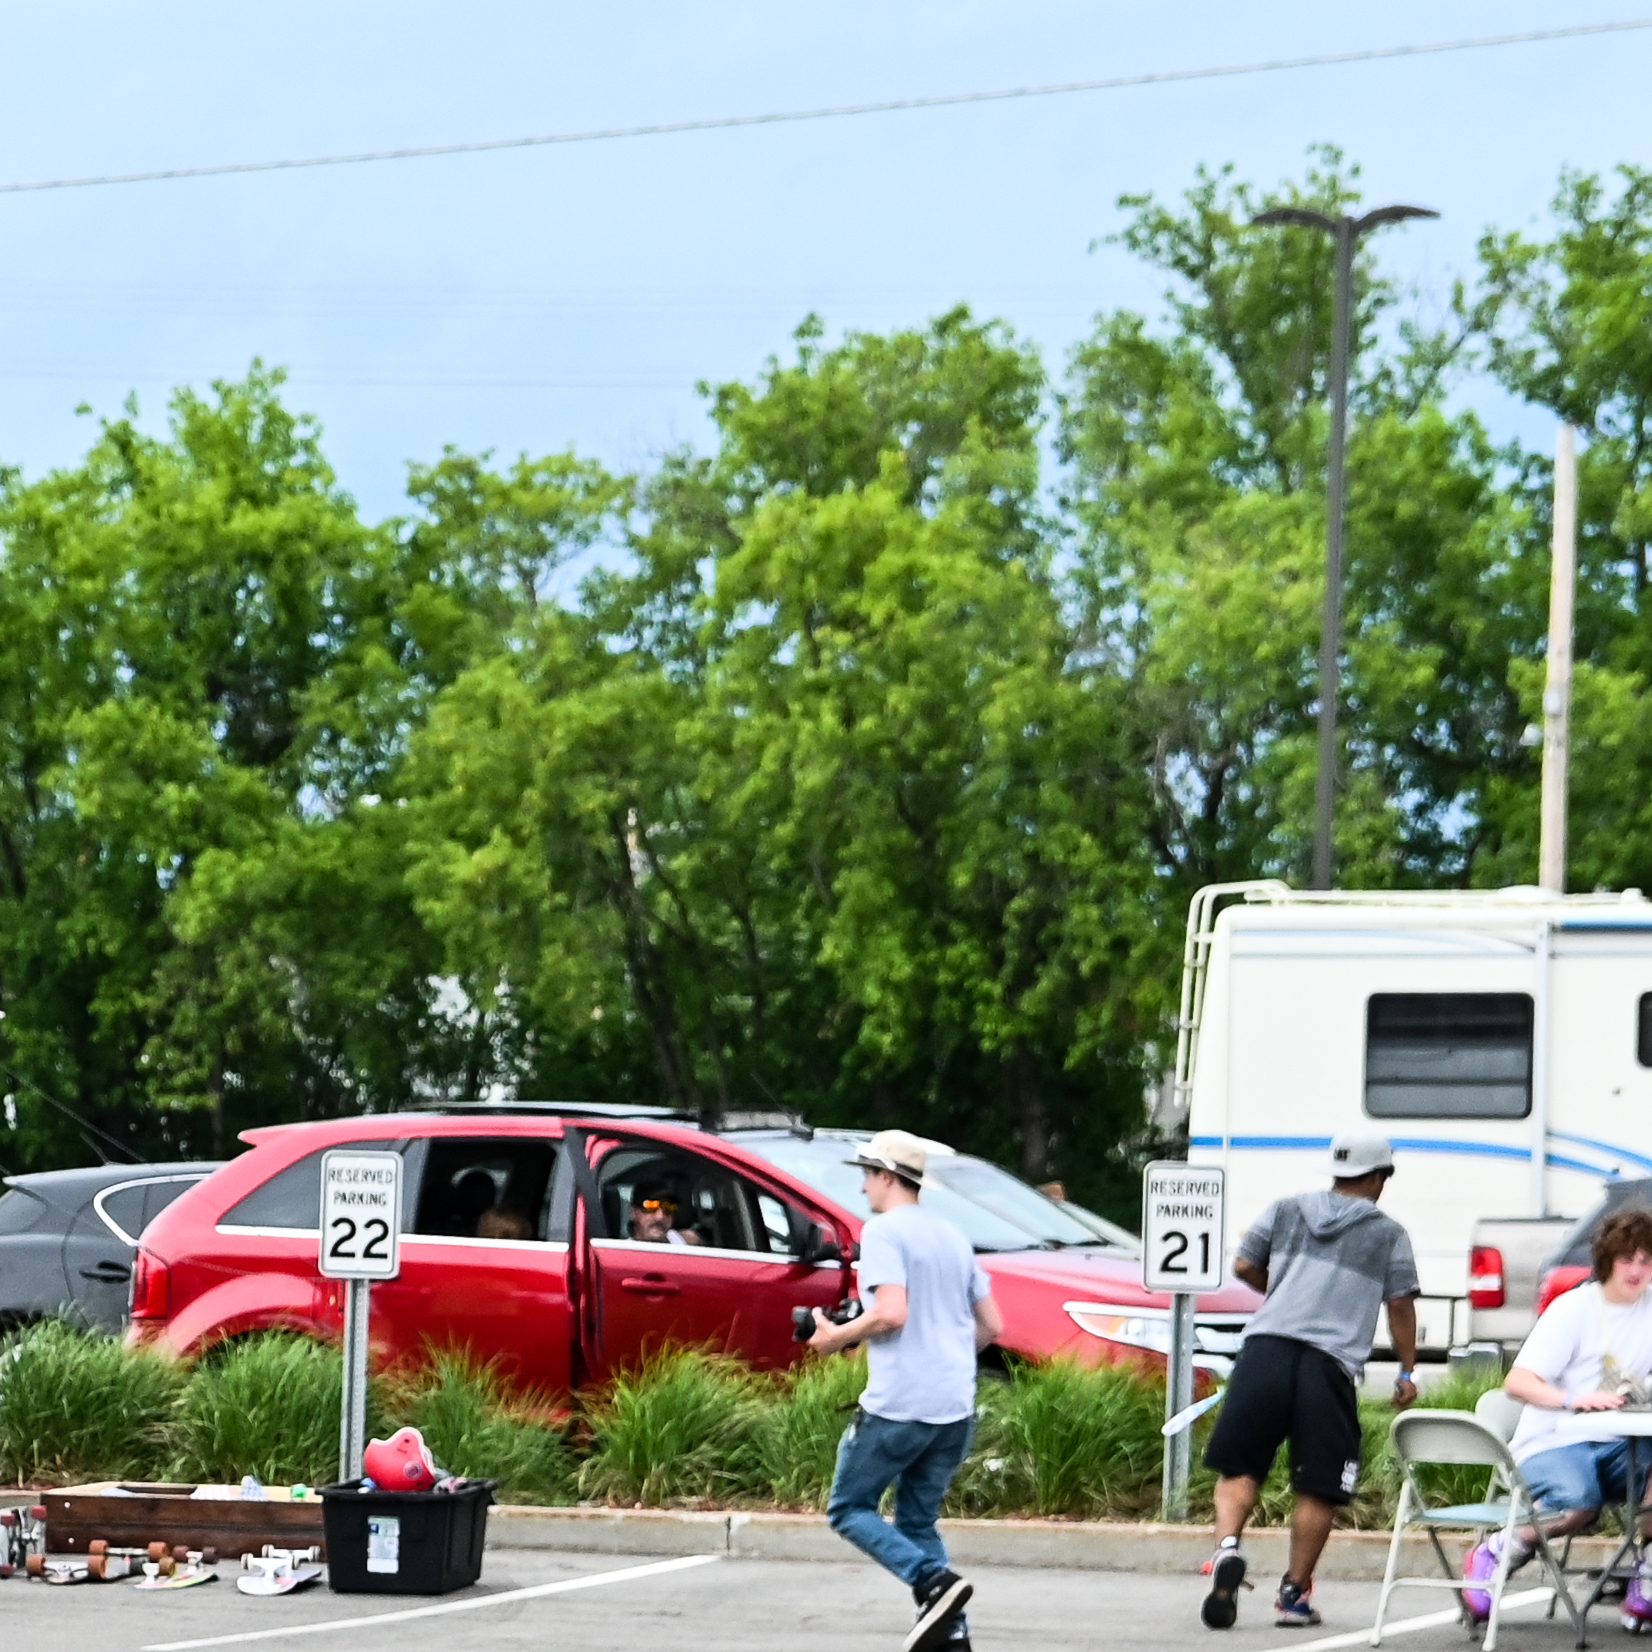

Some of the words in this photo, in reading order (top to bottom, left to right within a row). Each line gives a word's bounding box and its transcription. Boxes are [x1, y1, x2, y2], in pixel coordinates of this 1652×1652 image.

[328, 1168, 393, 1184] RESERVED
[1150, 1180, 1220, 1197] RESERVED
[333, 1191, 388, 1207] PARKING
[1156, 1203, 1214, 1219] PARKING
[329, 1217, 389, 1260] 22
[1159, 1230, 1210, 1275] 21
